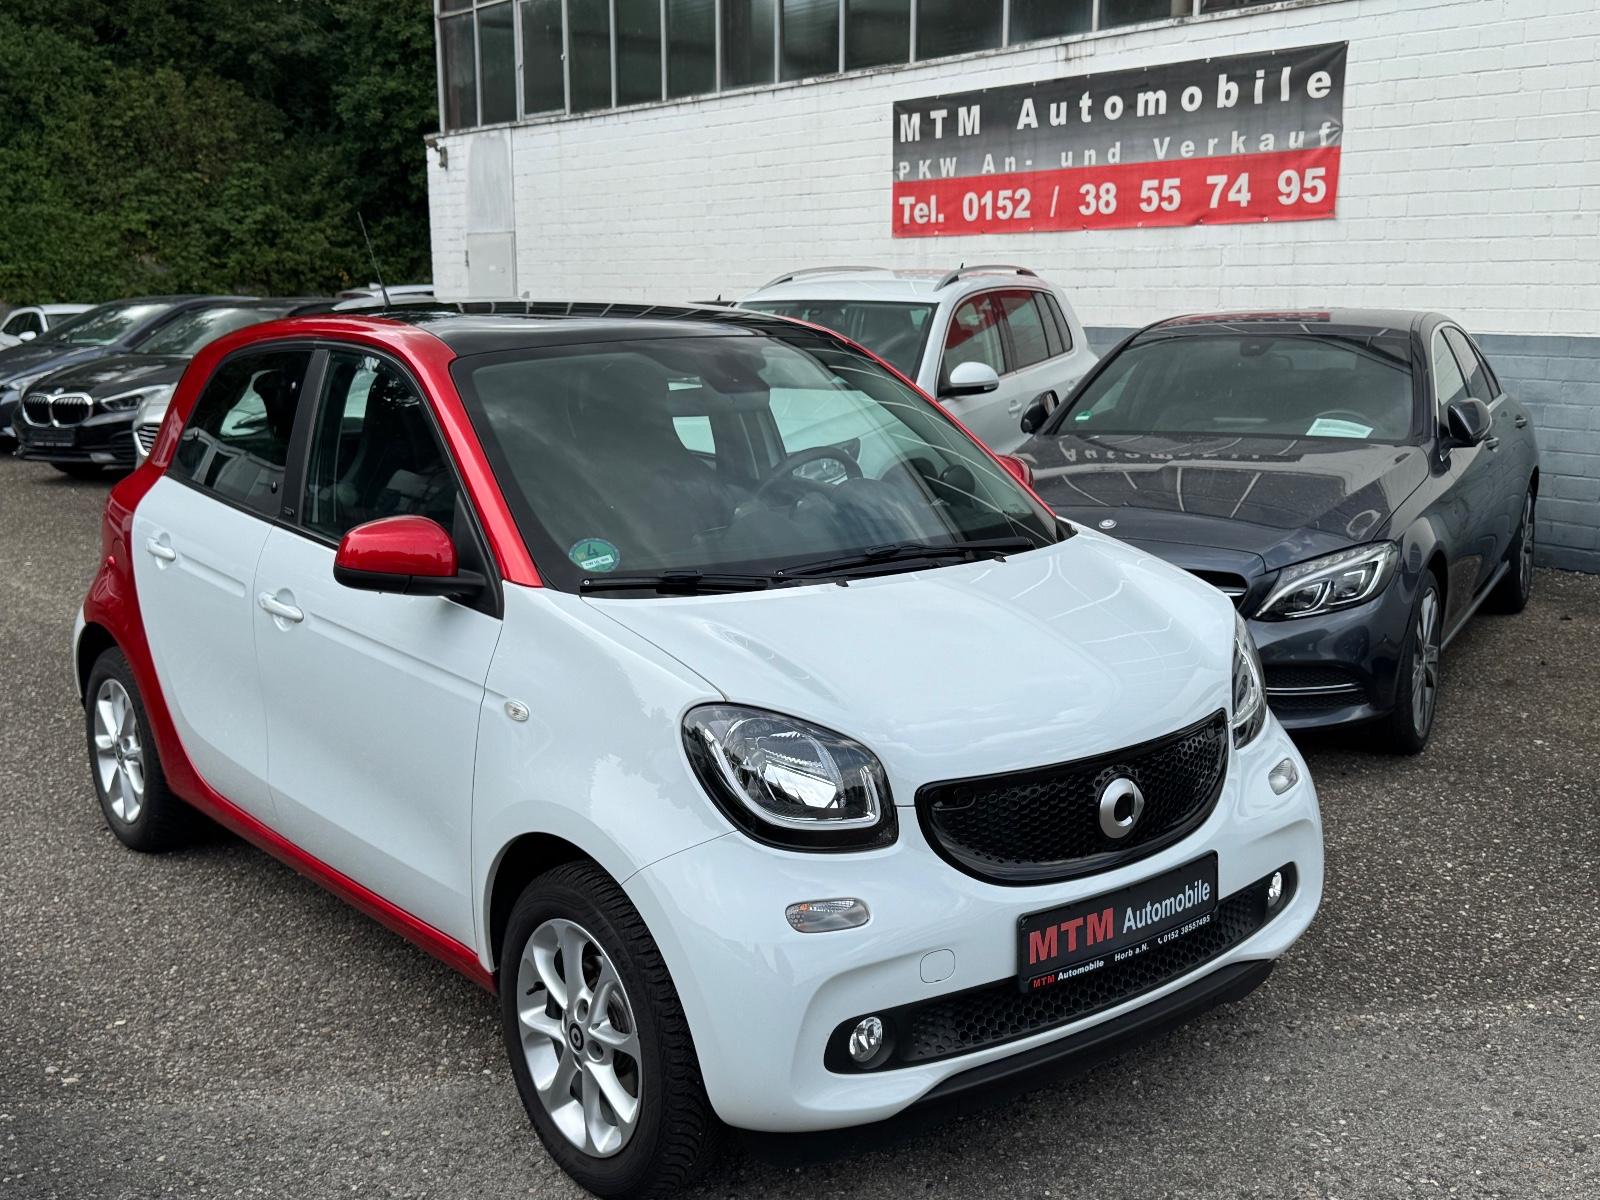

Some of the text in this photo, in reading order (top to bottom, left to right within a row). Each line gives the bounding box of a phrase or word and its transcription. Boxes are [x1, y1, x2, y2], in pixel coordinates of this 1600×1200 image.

[900, 66, 1332, 142] MTM Automobile
[899, 121, 1332, 180] PKW An- und Verkauf
[898, 194, 945, 225] Tel.
[962, 187, 1032, 222] 0152
[1078, 182, 1118, 216] 38
[1139, 178, 1182, 213] 55
[1206, 173, 1251, 209] 74
[1277, 167, 1327, 206] 95
[1029, 879, 1211, 965] MTM Automobile
[1033, 974, 1056, 988] MTM
[1057, 960, 1105, 981] Automobile
[1114, 948, 1134, 962] Horb
[1163, 929, 1180, 943] 0152
[1180, 914, 1211, 935] 38557495
